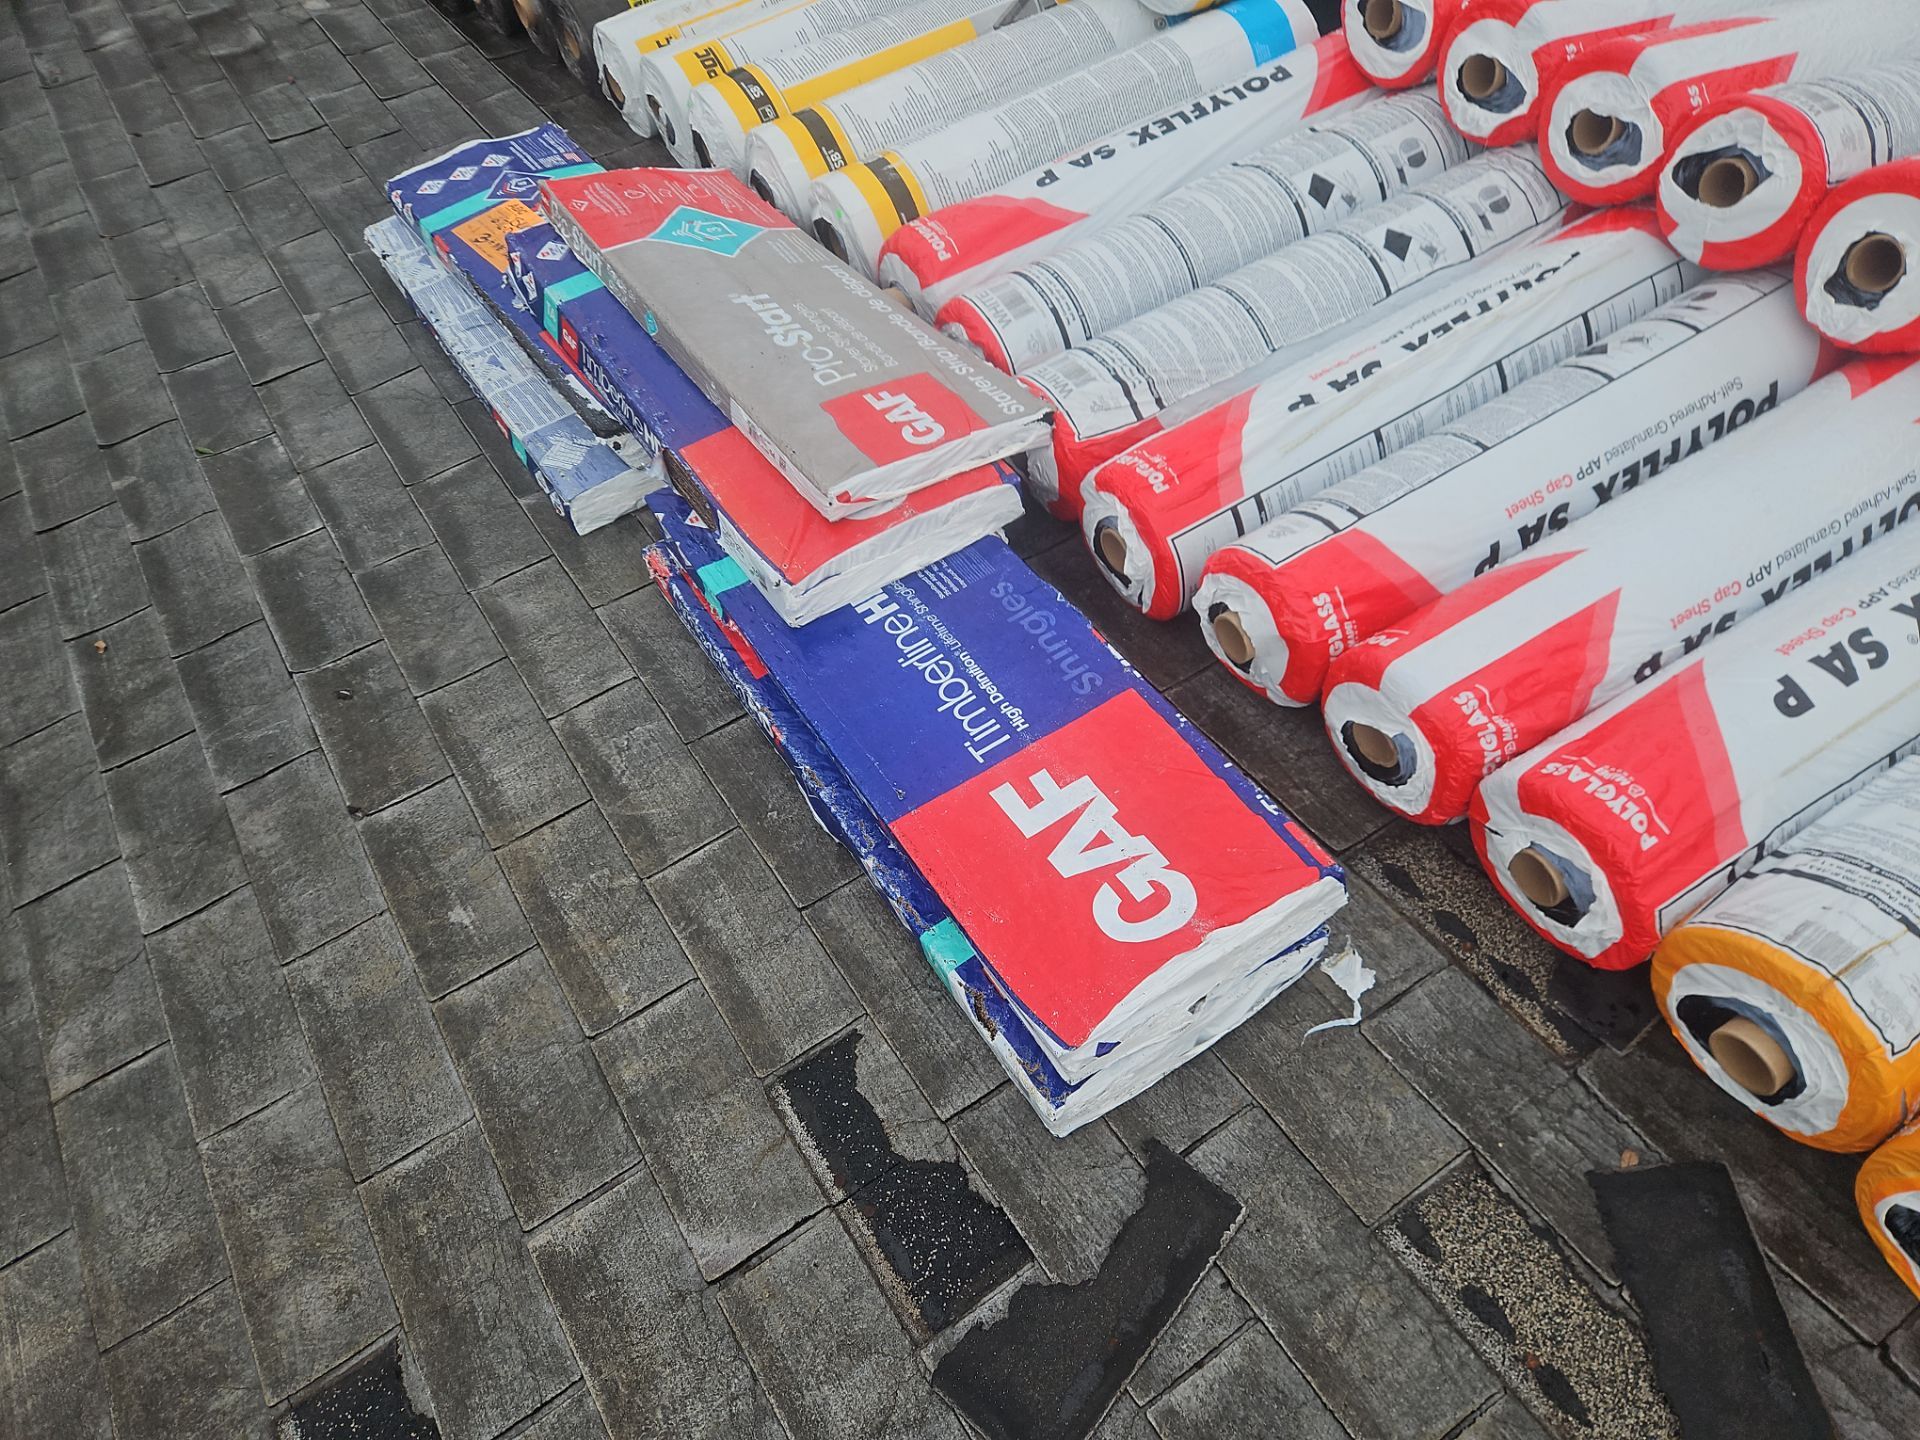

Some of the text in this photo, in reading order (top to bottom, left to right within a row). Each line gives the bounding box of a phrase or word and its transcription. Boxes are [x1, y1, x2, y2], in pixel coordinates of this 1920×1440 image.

[1034, 63, 1293, 189] POLYFLEX SA P
[866, 297, 893, 313] de
[974, 287, 1014, 330] WHITE
[862, 379, 948, 450] GAF
[966, 374, 1025, 415] Starter
[1503, 374, 1743, 521] Self-Adhered Granulated APP Cap Sheet
[1744, 560, 1773, 588] APP
[1773, 517, 1843, 571] Granulated
[1669, 597, 1712, 631] Sheet
[1712, 578, 1742, 605] Cap
[1775, 587, 1889, 656] APP Cap Sheet
[988, 576, 1107, 698] Shingles
[850, 586, 1011, 763] TimberlineH
[1773, 628, 1890, 718] SA P
[997, 700, 1029, 732] High
[1539, 763, 1660, 851] POLYGLASS
[989, 769, 1198, 943] GAF
